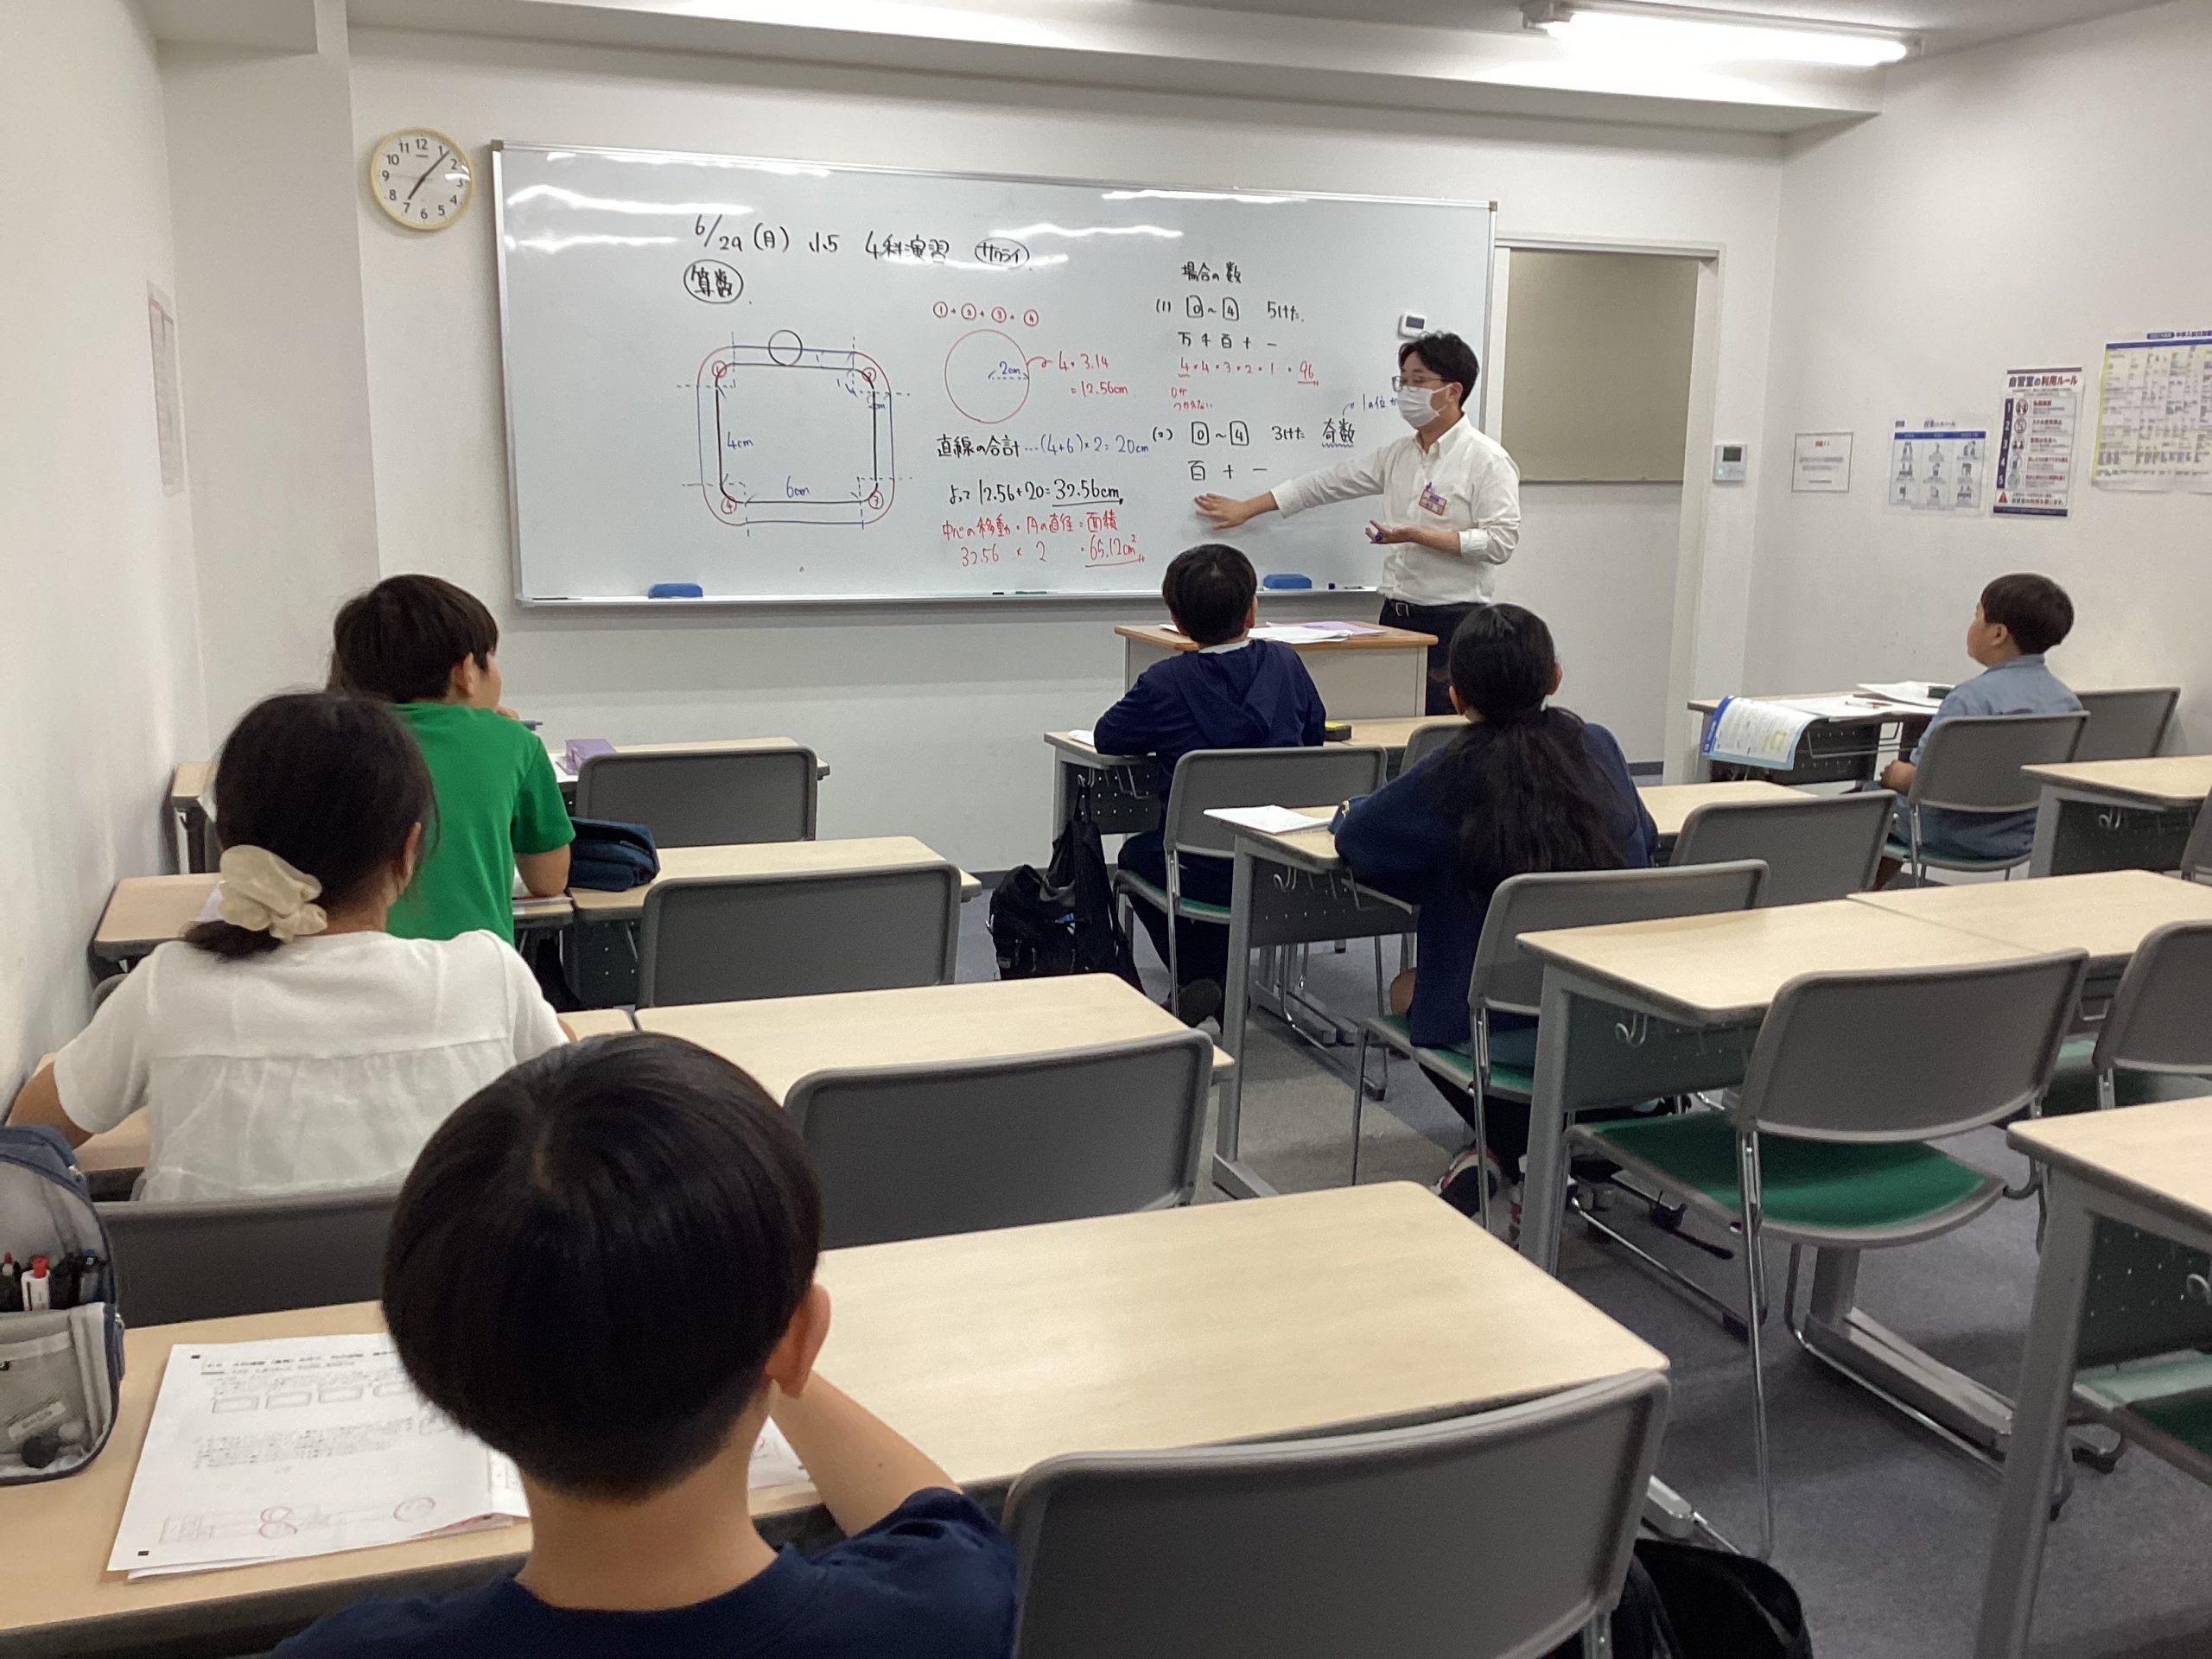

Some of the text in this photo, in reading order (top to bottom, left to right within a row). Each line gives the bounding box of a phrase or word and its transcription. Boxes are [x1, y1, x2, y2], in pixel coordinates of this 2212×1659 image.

[398, 143, 410, 153] 11
[416, 139, 428, 149] 12
[438, 145, 442, 155] 1
[387, 154, 399, 165] 10
[450, 159, 457, 169] 2
[382, 170, 390, 181] 9
[456, 178, 463, 187] 3
[389, 189, 397, 200] 8
[449, 195, 457, 205] 4
[404, 202, 410, 213] 7
[438, 205, 445, 216] 5
[420, 208, 428, 219] 6
[1181, 261, 1242, 283] 場合の数
[690, 264, 733, 297] 算数
[999, 360, 1021, 375] 2cm
[1323, 418, 1355, 443] 奇数
[727, 431, 754, 449] 4cm
[785, 475, 810, 499] 6cm
